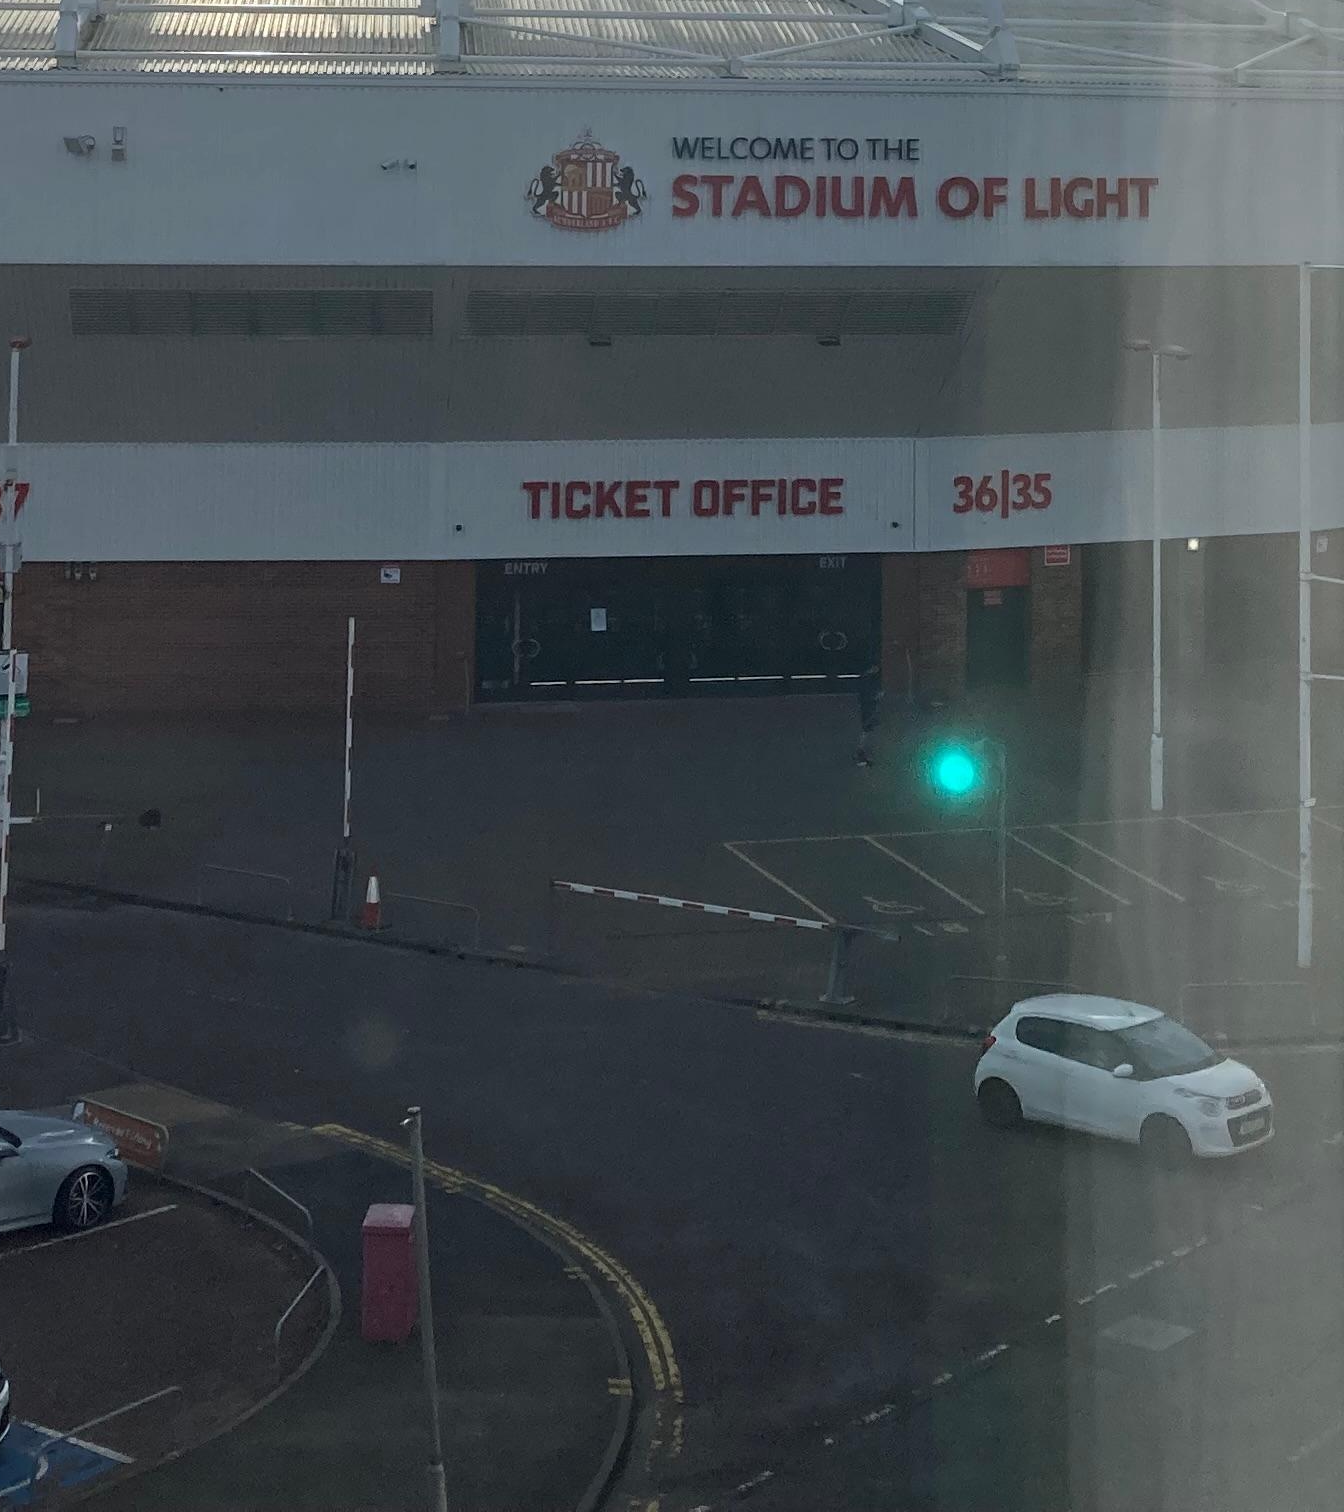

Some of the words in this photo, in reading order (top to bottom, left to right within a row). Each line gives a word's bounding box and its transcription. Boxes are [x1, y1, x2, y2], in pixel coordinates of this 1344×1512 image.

[672, 136, 814, 161] WELCOME
[820, 137, 859, 161] TO
[865, 138, 920, 162] THE
[671, 175, 918, 218] STADIUM
[938, 177, 1008, 218] OF
[1024, 177, 1158, 219] LIGHT
[523, 480, 679, 519] TICKET
[693, 479, 844, 517] OFFICE
[504, 561, 549, 575] ENTRY
[819, 556, 848, 569] EXIT
